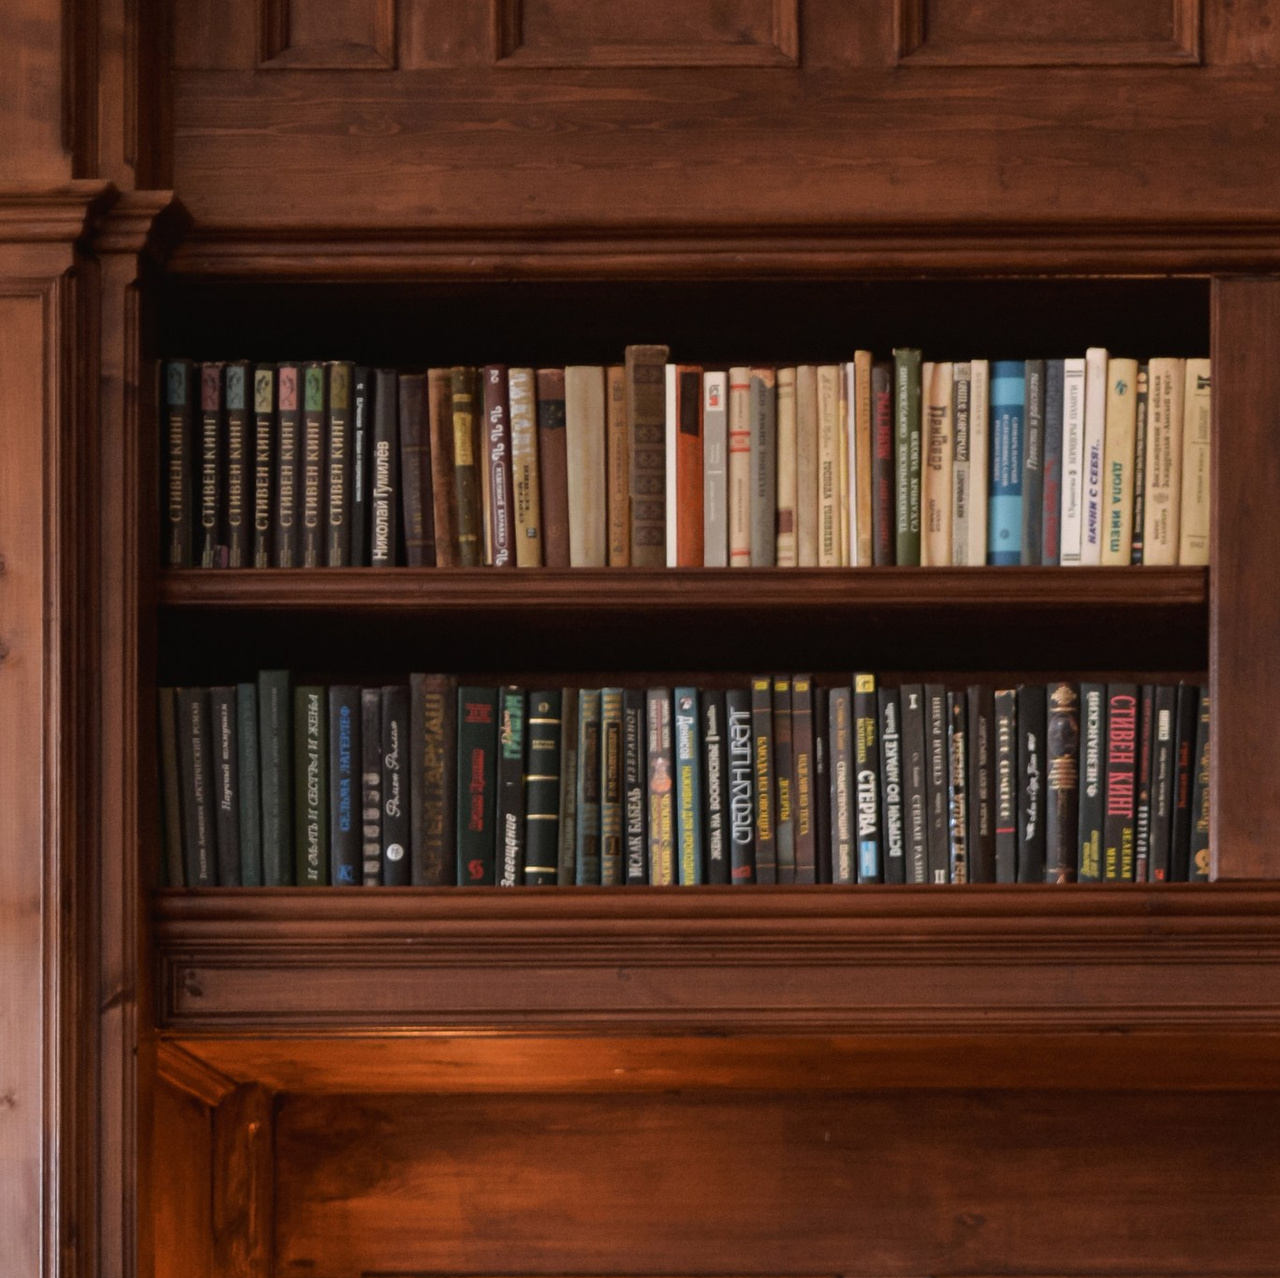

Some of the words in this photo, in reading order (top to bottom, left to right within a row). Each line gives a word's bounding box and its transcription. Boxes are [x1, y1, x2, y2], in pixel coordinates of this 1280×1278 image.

[1029, 373, 1041, 418] рассказы
[169, 412, 182, 455] КИНГ
[203, 415, 216, 459] КИНГ
[229, 416, 242, 459] КИНГ
[256, 417, 269, 461] КИНГ
[281, 418, 293, 460] КИНГ
[306, 419, 319, 460] КИНГ
[331, 416, 344, 458] КИНГ
[1026, 428, 1039, 470] Повести
[169, 460, 183, 521] СТИВЕН
[202, 464, 215, 527] СТИВЕН
[229, 464, 241, 525] СТИВЕН
[256, 467, 269, 530] СТИВЕН
[280, 465, 293, 527] СТИВЕН
[305, 466, 318, 527] СТИВЕН
[330, 464, 343, 525] СТИВЕН
[1089, 489, 1098, 497] С
[374, 500, 388, 559] Николай
[1088, 501, 1098, 544] НАЧНИ
[191, 702, 201, 734] РОМАН
[221, 703, 231, 760] коммунизм
[308, 694, 318, 737] ЖЕНА
[932, 696, 941, 734] РАЗИН
[1109, 695, 1136, 763] СТИВЕН
[308, 739, 318, 750] И
[385, 720, 400, 770] Роллан
[425, 693, 444, 795] ГАРМАШ
[627, 708, 636, 783] ИЗБРАННОЕ
[677, 715, 693, 760] Денисов
[757, 736, 767, 774] БЛЮДА
[952, 732, 964, 786] ЗВЕЗДА
[193, 737, 204, 803] АРКТИЧЕСКИЙ
[308, 753, 318, 806] СЕСТРА
[709, 743, 720, 810] ВОСКРЕСЕНЬЕ
[885, 741, 898, 782] МРАКЕ
[933, 739, 942, 785] СТЕПАН
[221, 764, 232, 810] Научный
[339, 778, 351, 831] СЕЛЬМА
[386, 773, 401, 817] Ромен
[682, 765, 691, 809] НАЖИВКА
[759, 776, 768, 792] ИЗ
[837, 761, 848, 840] СТРАНСТВУЮЩИЙ
[858, 770, 876, 836] СТЕРВА
[887, 784, 899, 802] ВО
[1108, 771, 1134, 818] КИНГ
[308, 809, 318, 820] И
[627, 787, 642, 834] БАБЕЛЬ
[681, 811, 692, 829] ДЛЯ
[711, 812, 721, 828] НА
[731, 769, 752, 844] СТЕФАН
[757, 794, 771, 840] ОВОЩЕЙ
[800, 807, 809, 836] ТЕСТА
[912, 794, 922, 840] СТЕПАН
[953, 793, 964, 837] ВАША
[308, 822, 319, 865] МАТЬ
[501, 813, 520, 886] Завещание
[711, 828, 721, 860] ЖЕНА
[889, 804, 902, 857] ВСТРЕЧИ
[308, 867, 318, 880] И
[628, 836, 642, 878] ИСААК
[914, 845, 923, 883] РАЗИН
[1106, 847, 1116, 878] МИЛЯ
